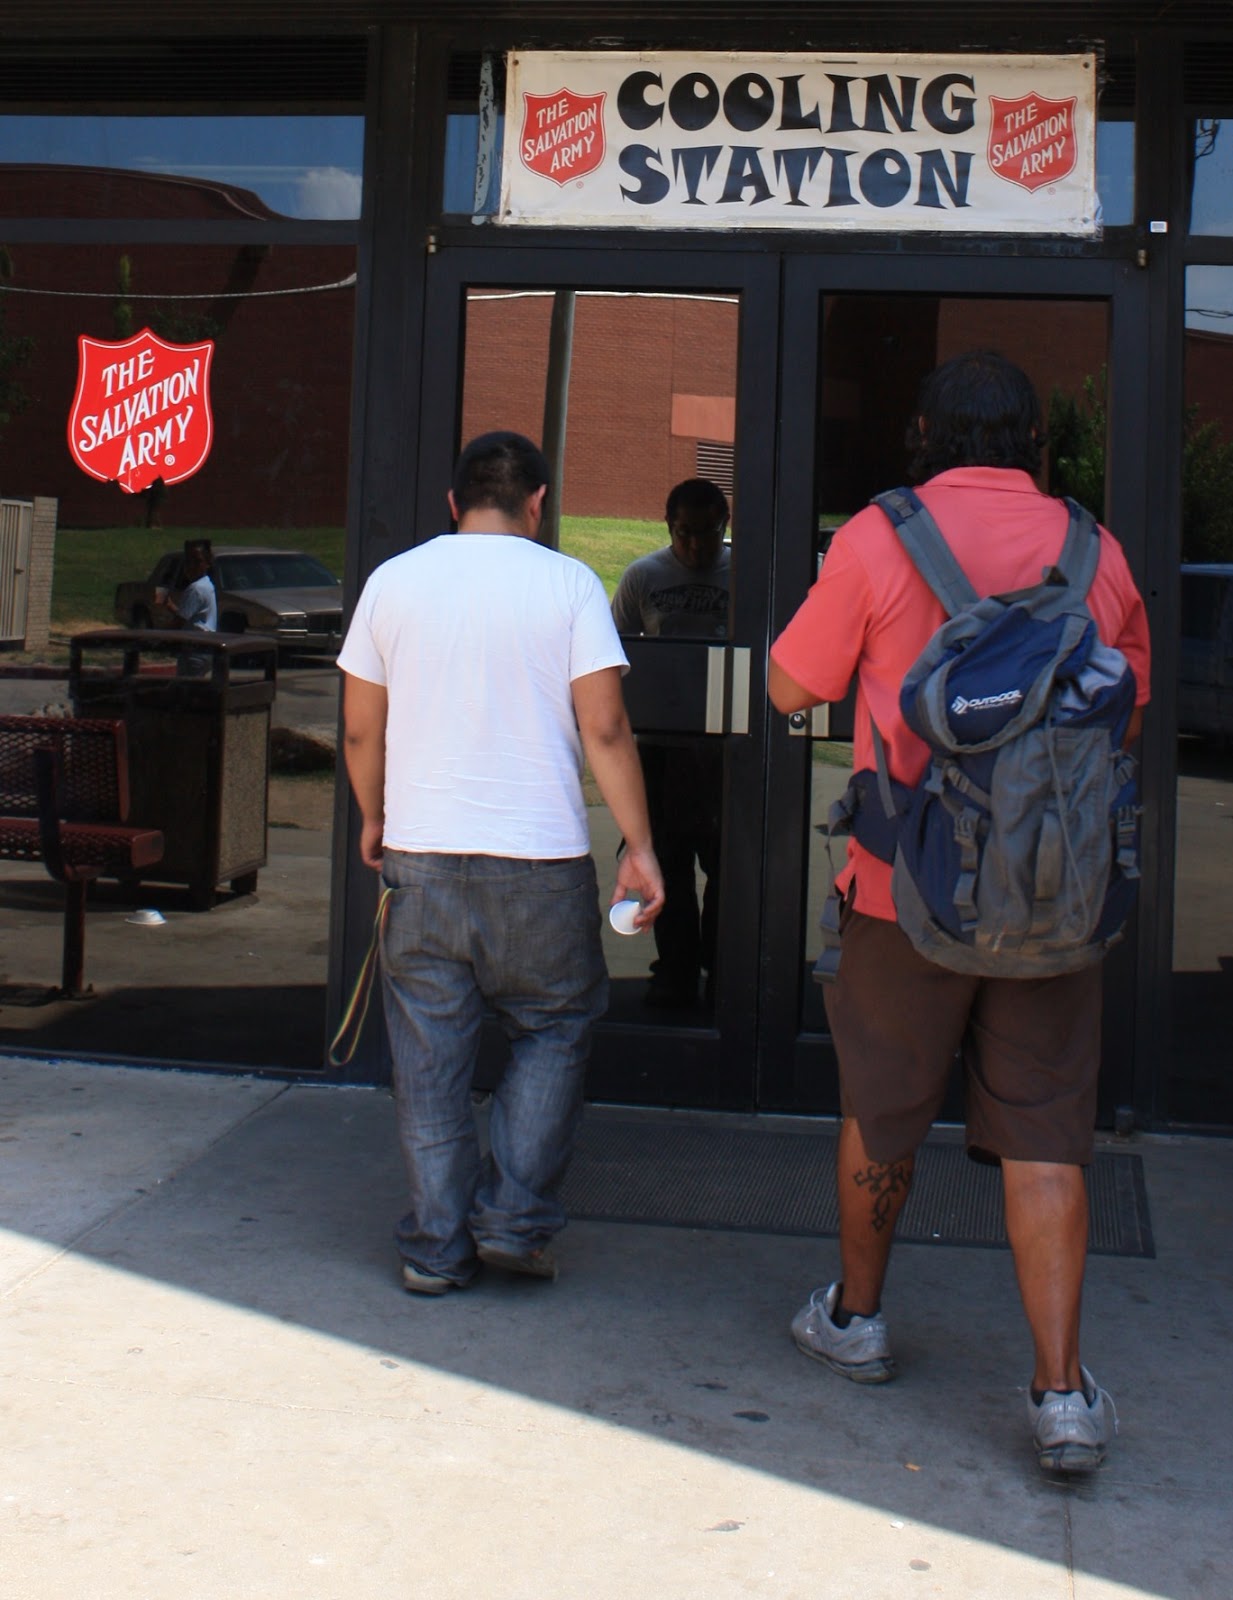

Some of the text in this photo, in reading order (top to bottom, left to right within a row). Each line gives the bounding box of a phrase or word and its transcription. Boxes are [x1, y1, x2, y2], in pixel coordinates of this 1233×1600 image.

[523, 102, 597, 162] SALVATION
[535, 98, 569, 129] THE
[617, 70, 977, 135] COOLING
[1003, 102, 1039, 134] THE
[549, 130, 595, 174] ARMY
[991, 107, 1068, 167] SALVATION
[1020, 135, 1066, 180] ARMY
[618, 143, 976, 209] STATION
[101, 348, 156, 399] THE
[78, 358, 200, 453] SALVATION
[116, 405, 194, 477] ARMY
